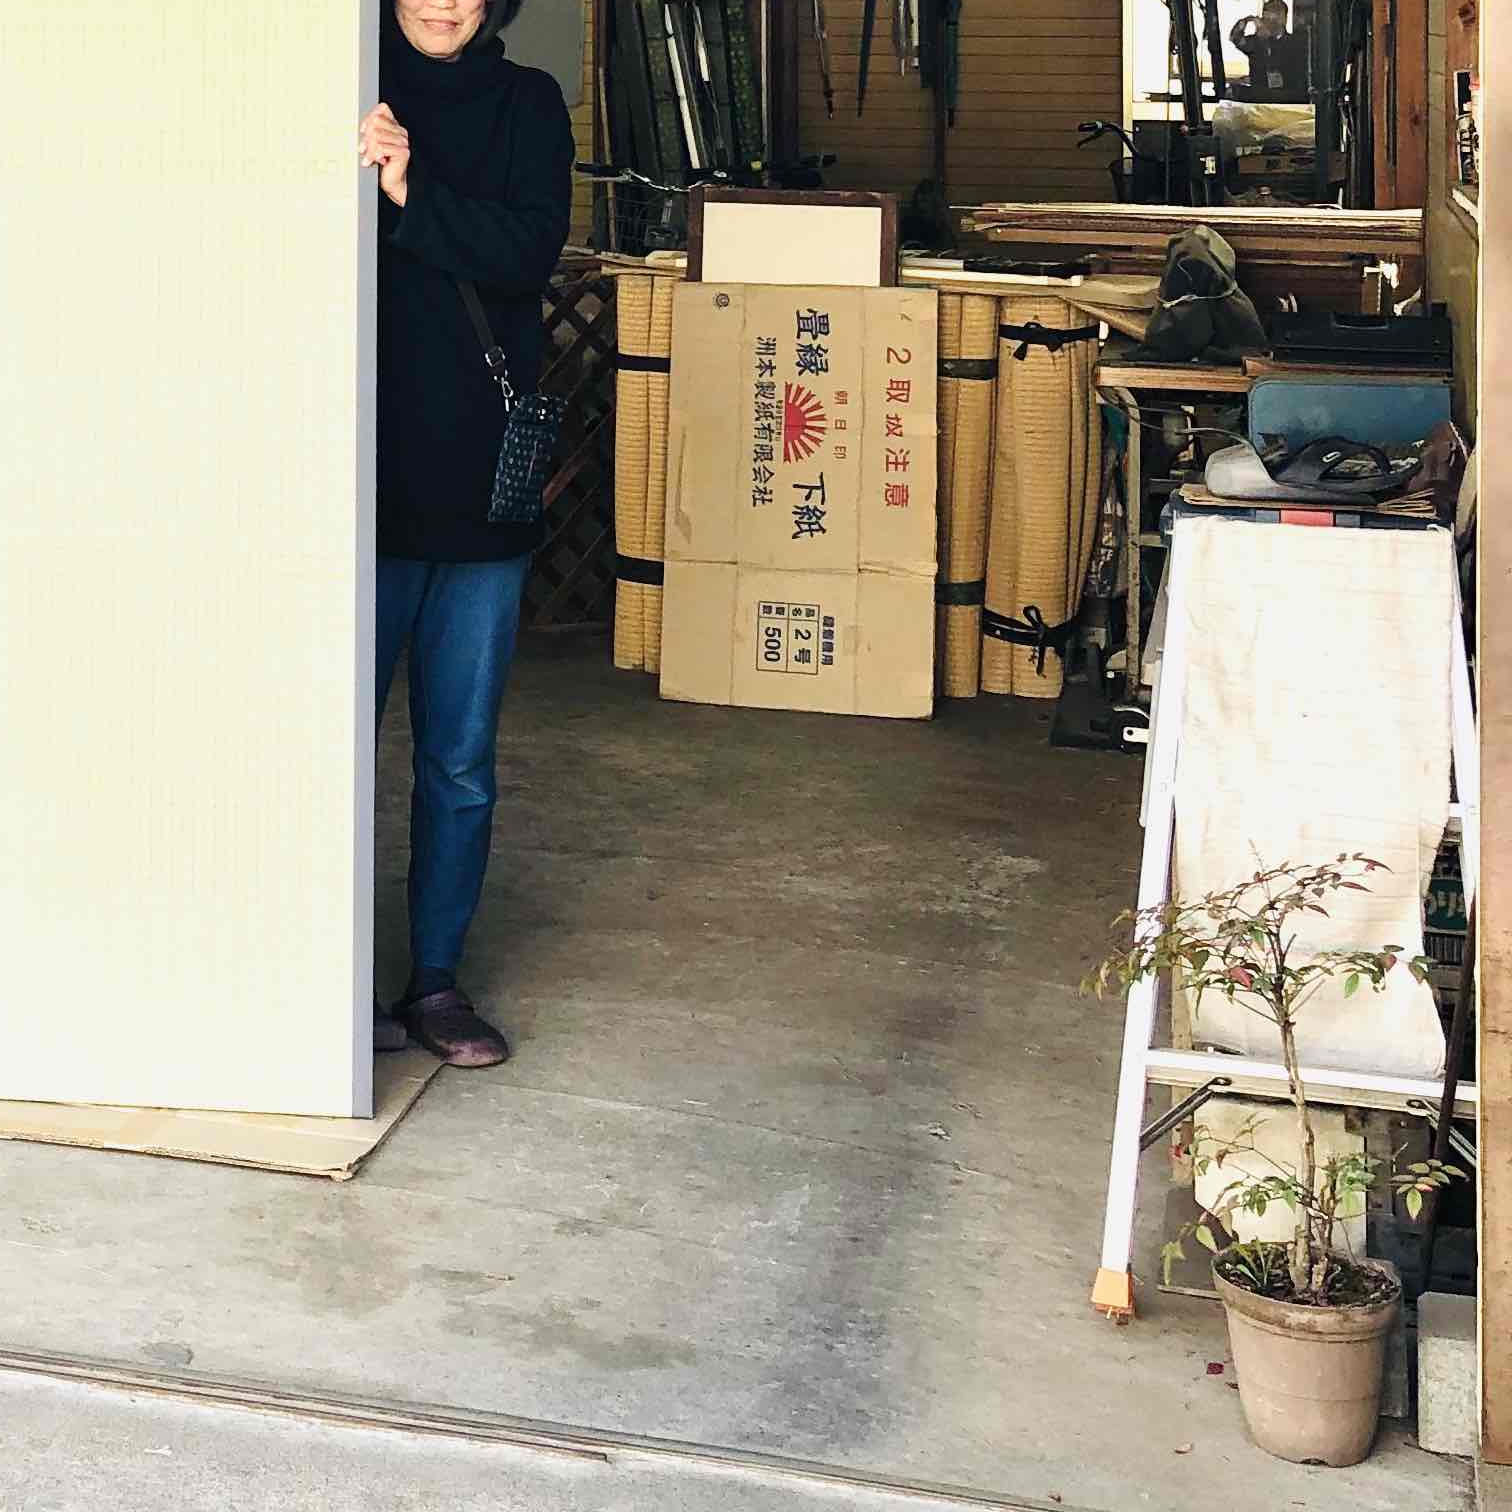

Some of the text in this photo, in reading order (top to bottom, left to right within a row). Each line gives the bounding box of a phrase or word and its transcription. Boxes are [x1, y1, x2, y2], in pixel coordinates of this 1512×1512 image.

[752, 336, 776, 508] 洲本製紙有限会社
[791, 308, 830, 540] 畳縁 下紙
[764, 626, 782, 663] 500
